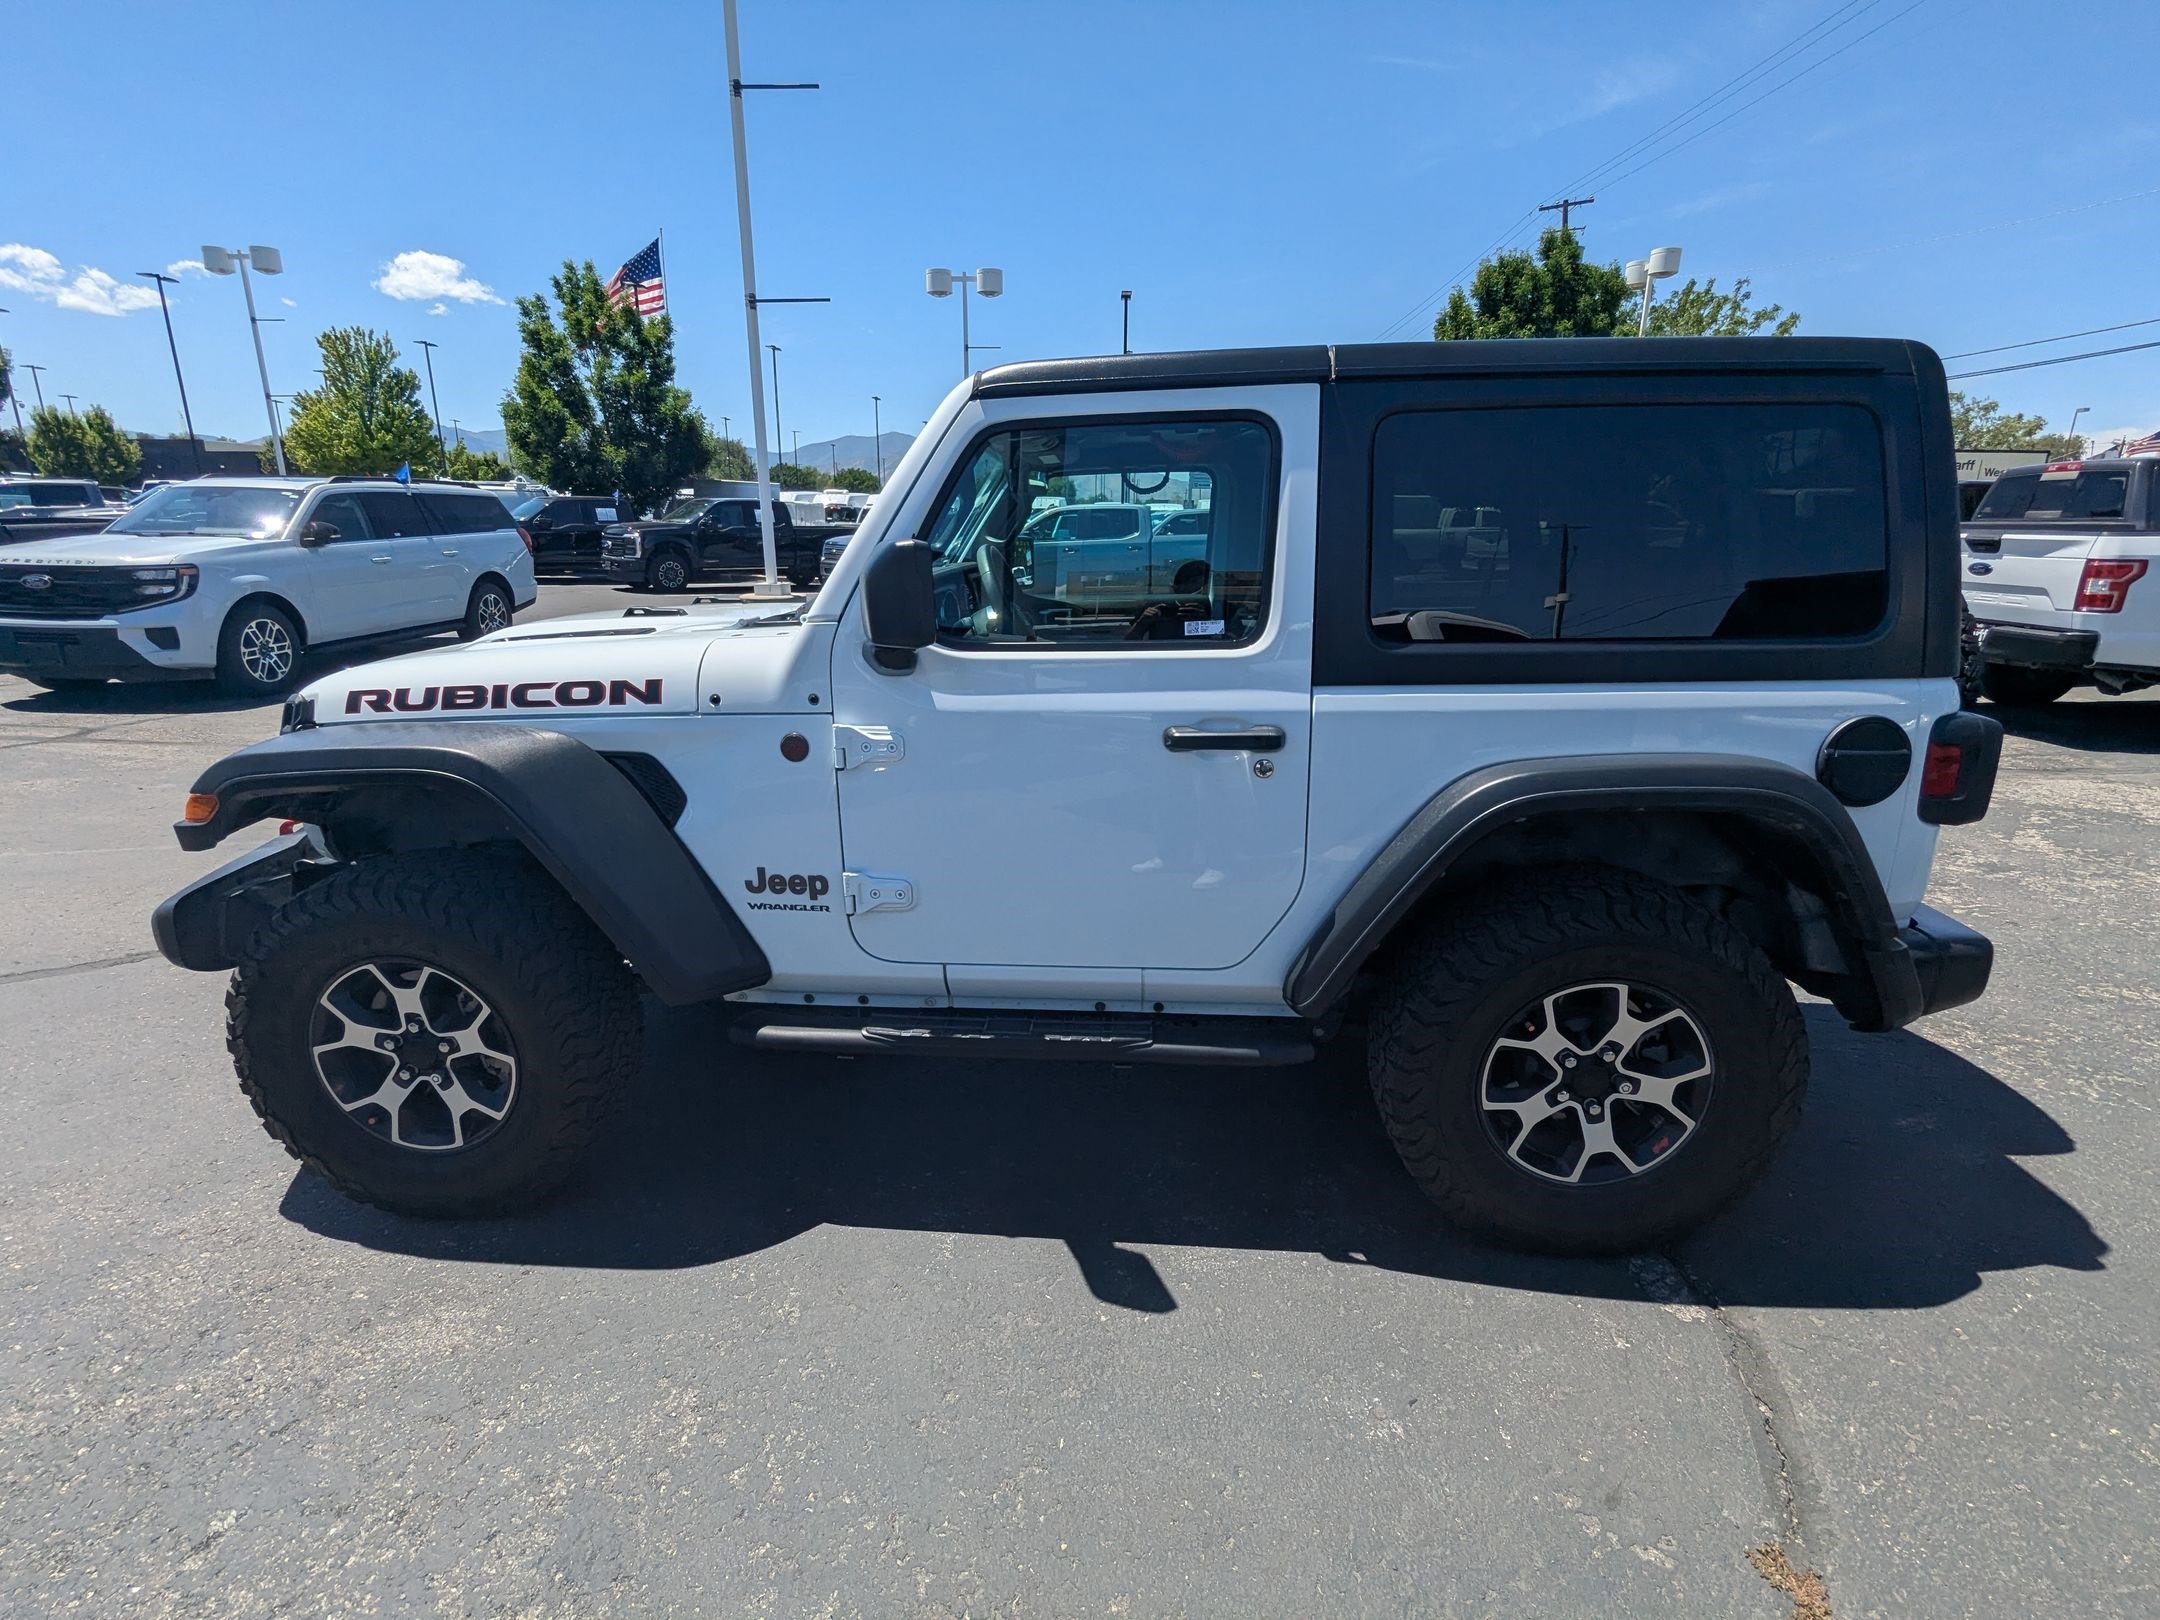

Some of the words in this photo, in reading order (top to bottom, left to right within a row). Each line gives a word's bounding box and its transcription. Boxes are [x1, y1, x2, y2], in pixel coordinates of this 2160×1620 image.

[344, 678, 664, 715] RUBICON
[744, 866, 830, 901] Jeep
[747, 902, 831, 913] WRANGLER
